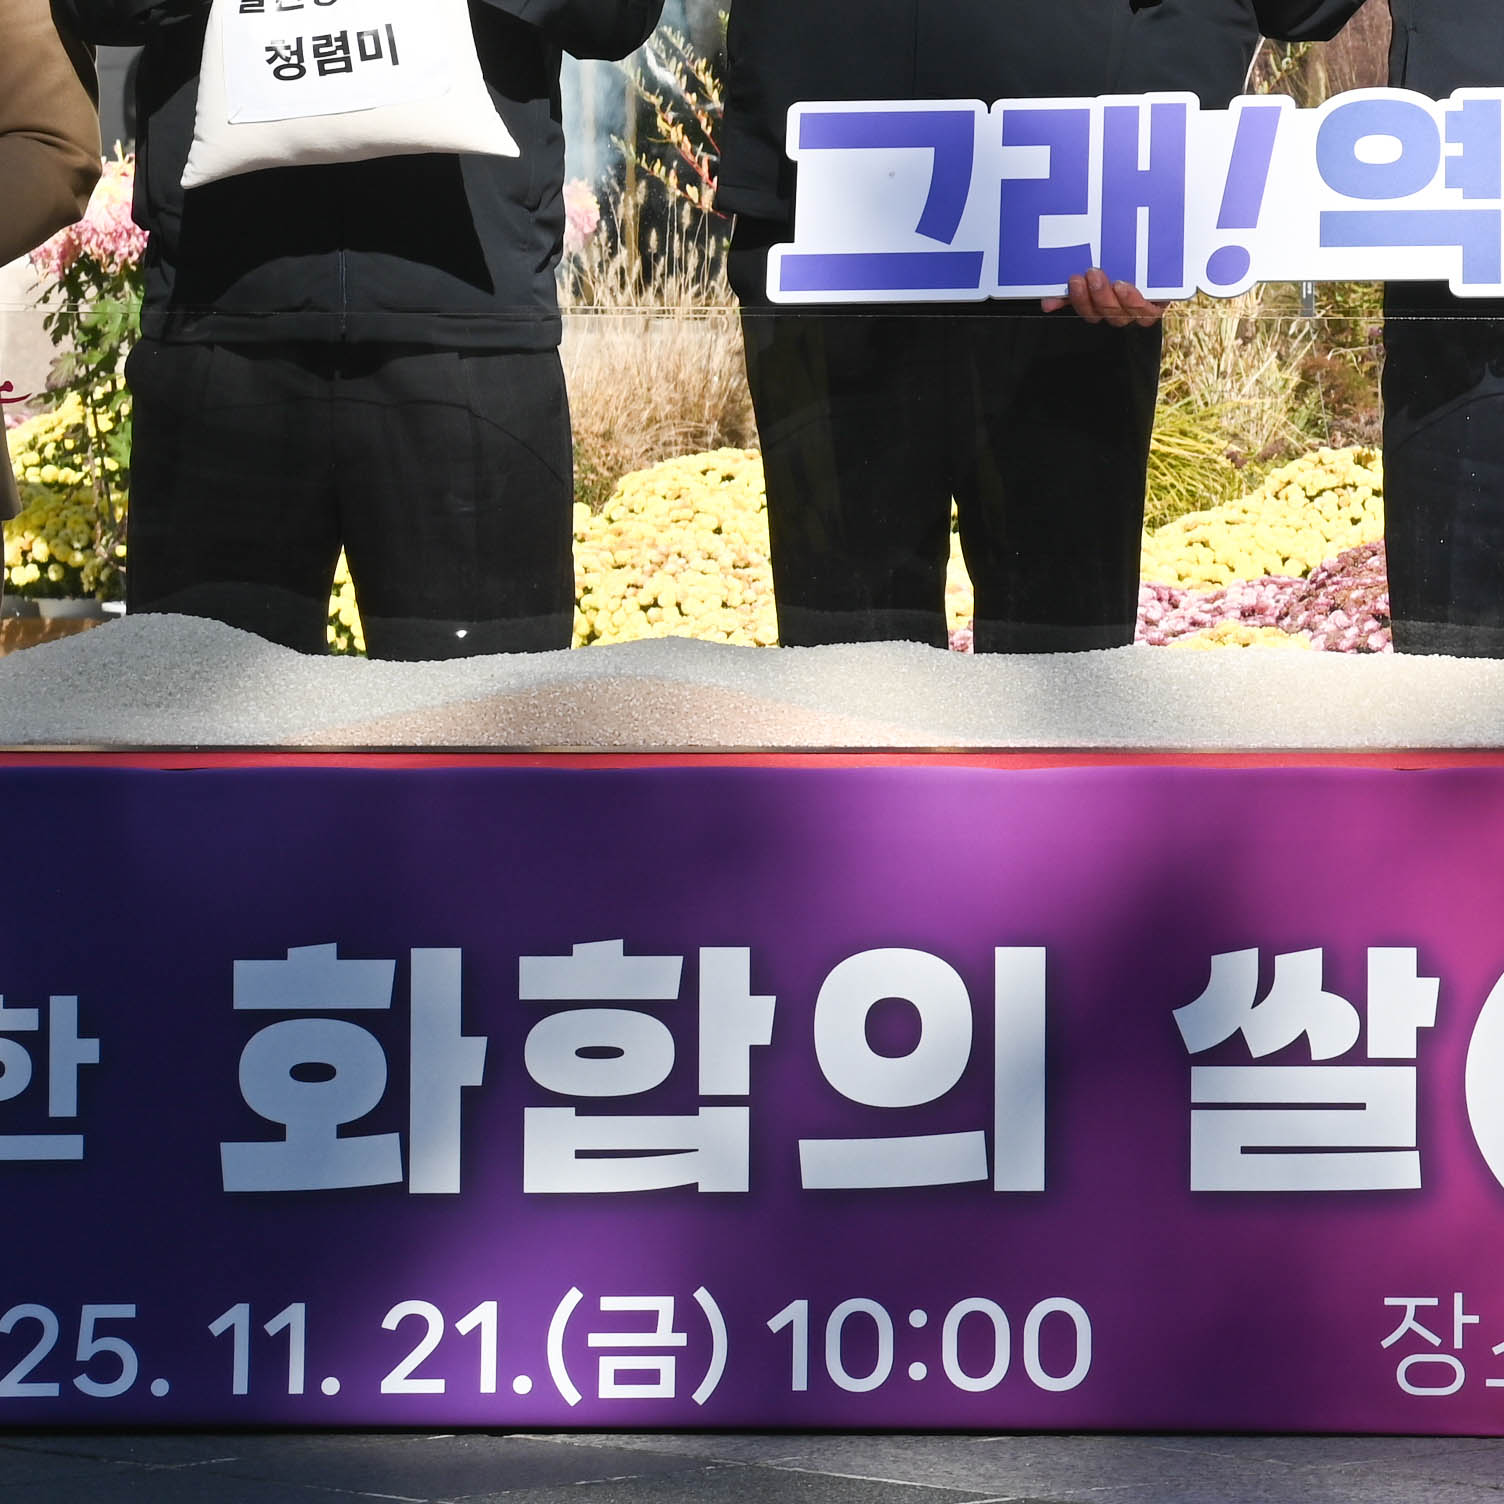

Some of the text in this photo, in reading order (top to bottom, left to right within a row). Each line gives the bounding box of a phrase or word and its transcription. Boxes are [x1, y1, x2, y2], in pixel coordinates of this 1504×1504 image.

[265, 23, 400, 81] 청렴미
[779, 102, 1281, 291] 그래!
[220, 939, 1047, 1194] 화합의
[0, 1286, 1092, 1407] 25. 11. 21.(금) 10:00
